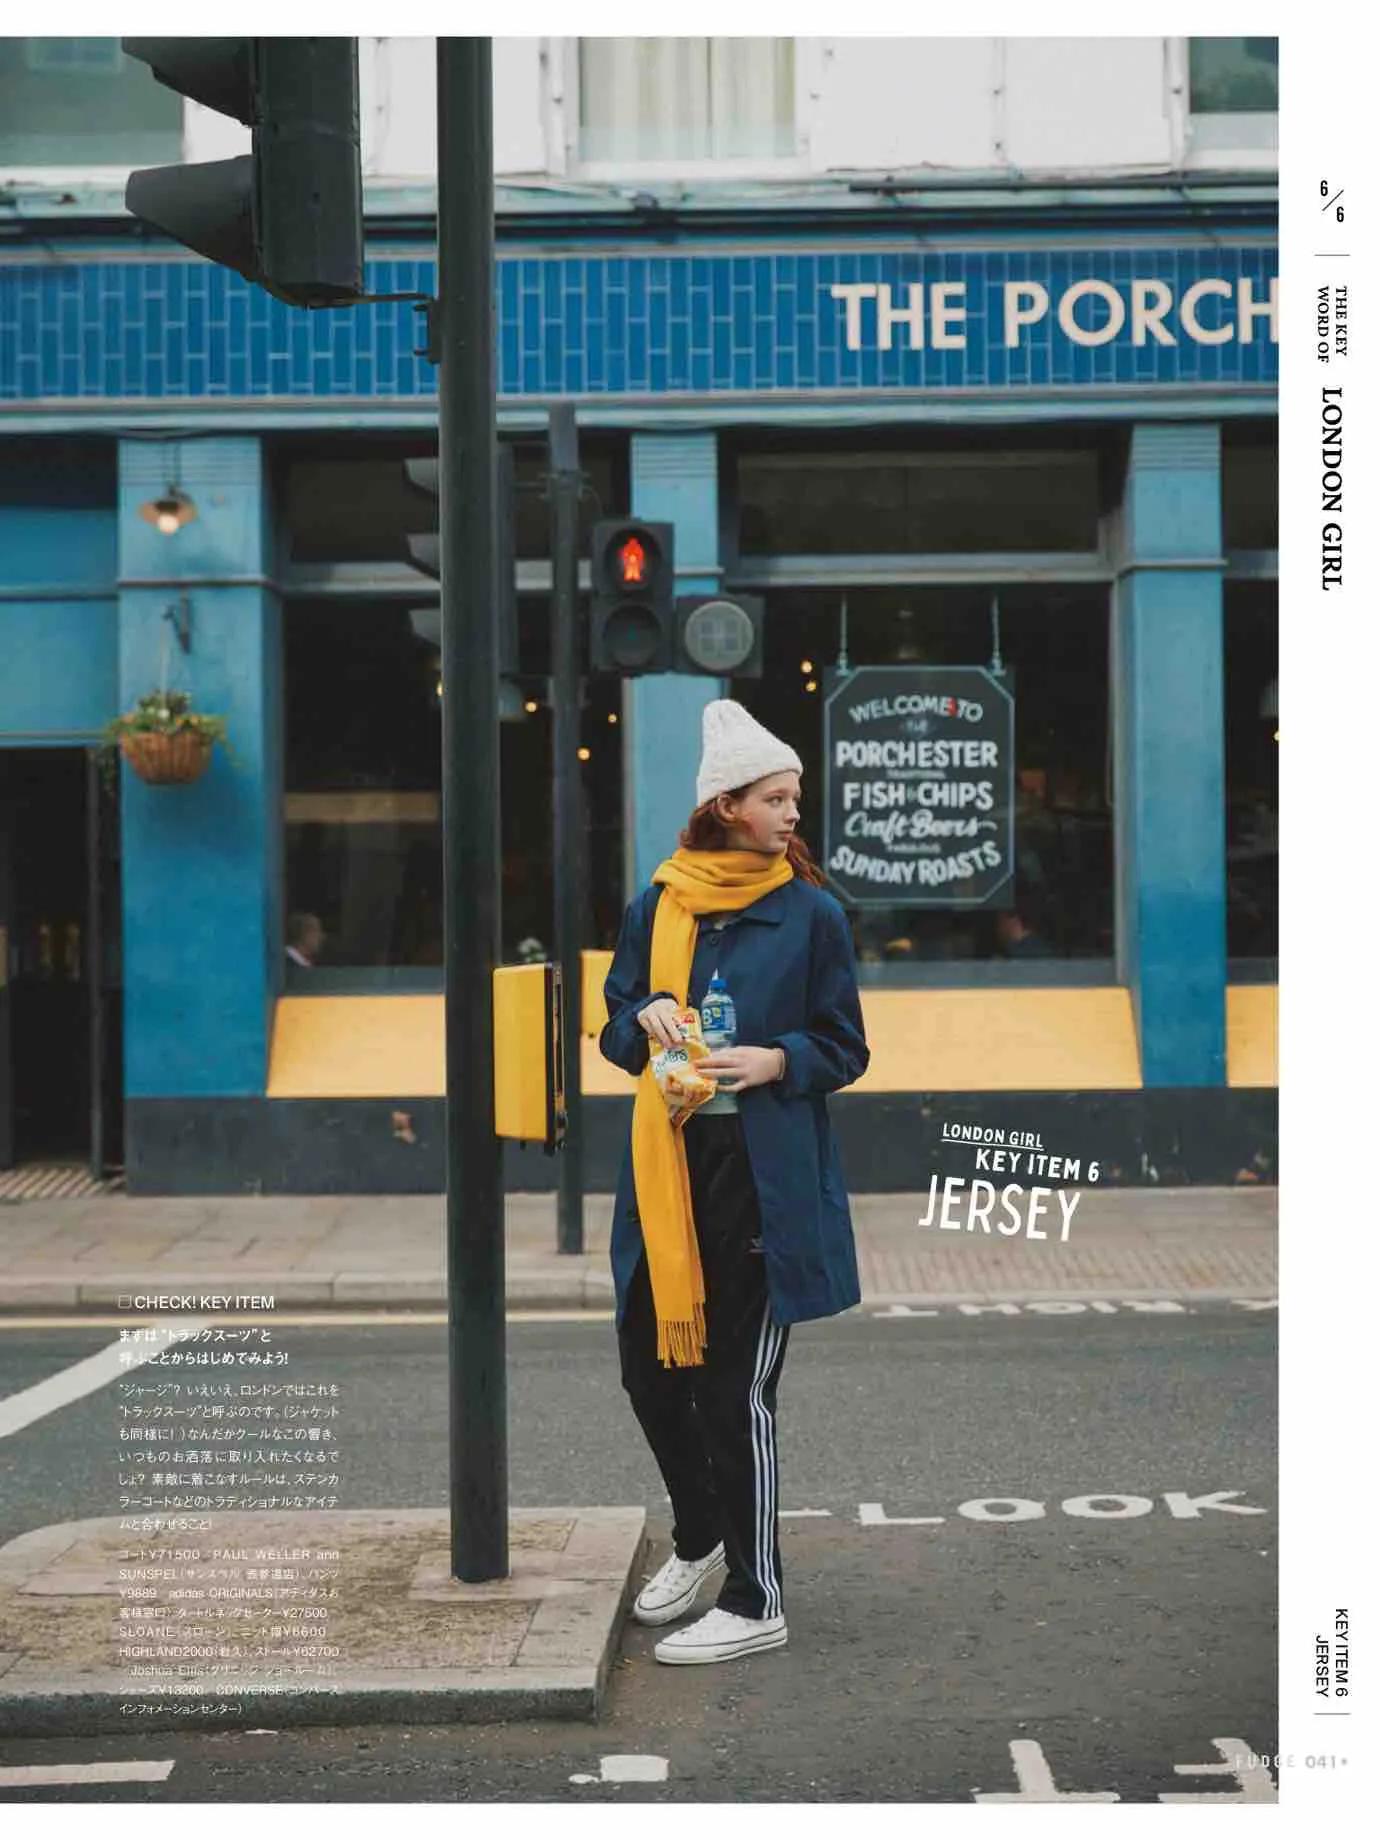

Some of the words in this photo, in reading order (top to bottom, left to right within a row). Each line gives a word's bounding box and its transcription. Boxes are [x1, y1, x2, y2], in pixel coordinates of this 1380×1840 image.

[830, 281, 967, 351] THE
[1003, 277, 1280, 349] PORCH
[849, 694, 954, 724] WELCOME
[956, 698, 984, 723] TO
[835, 740, 999, 768] PORCHESTER
[843, 781, 906, 811] FISH
[916, 780, 994, 811] CHIPS
[844, 810, 909, 844] Craft
[830, 845, 916, 885] SUNDAY
[917, 840, 1002, 886] ROASTS
[854, 1489, 1270, 1526] LOOK
